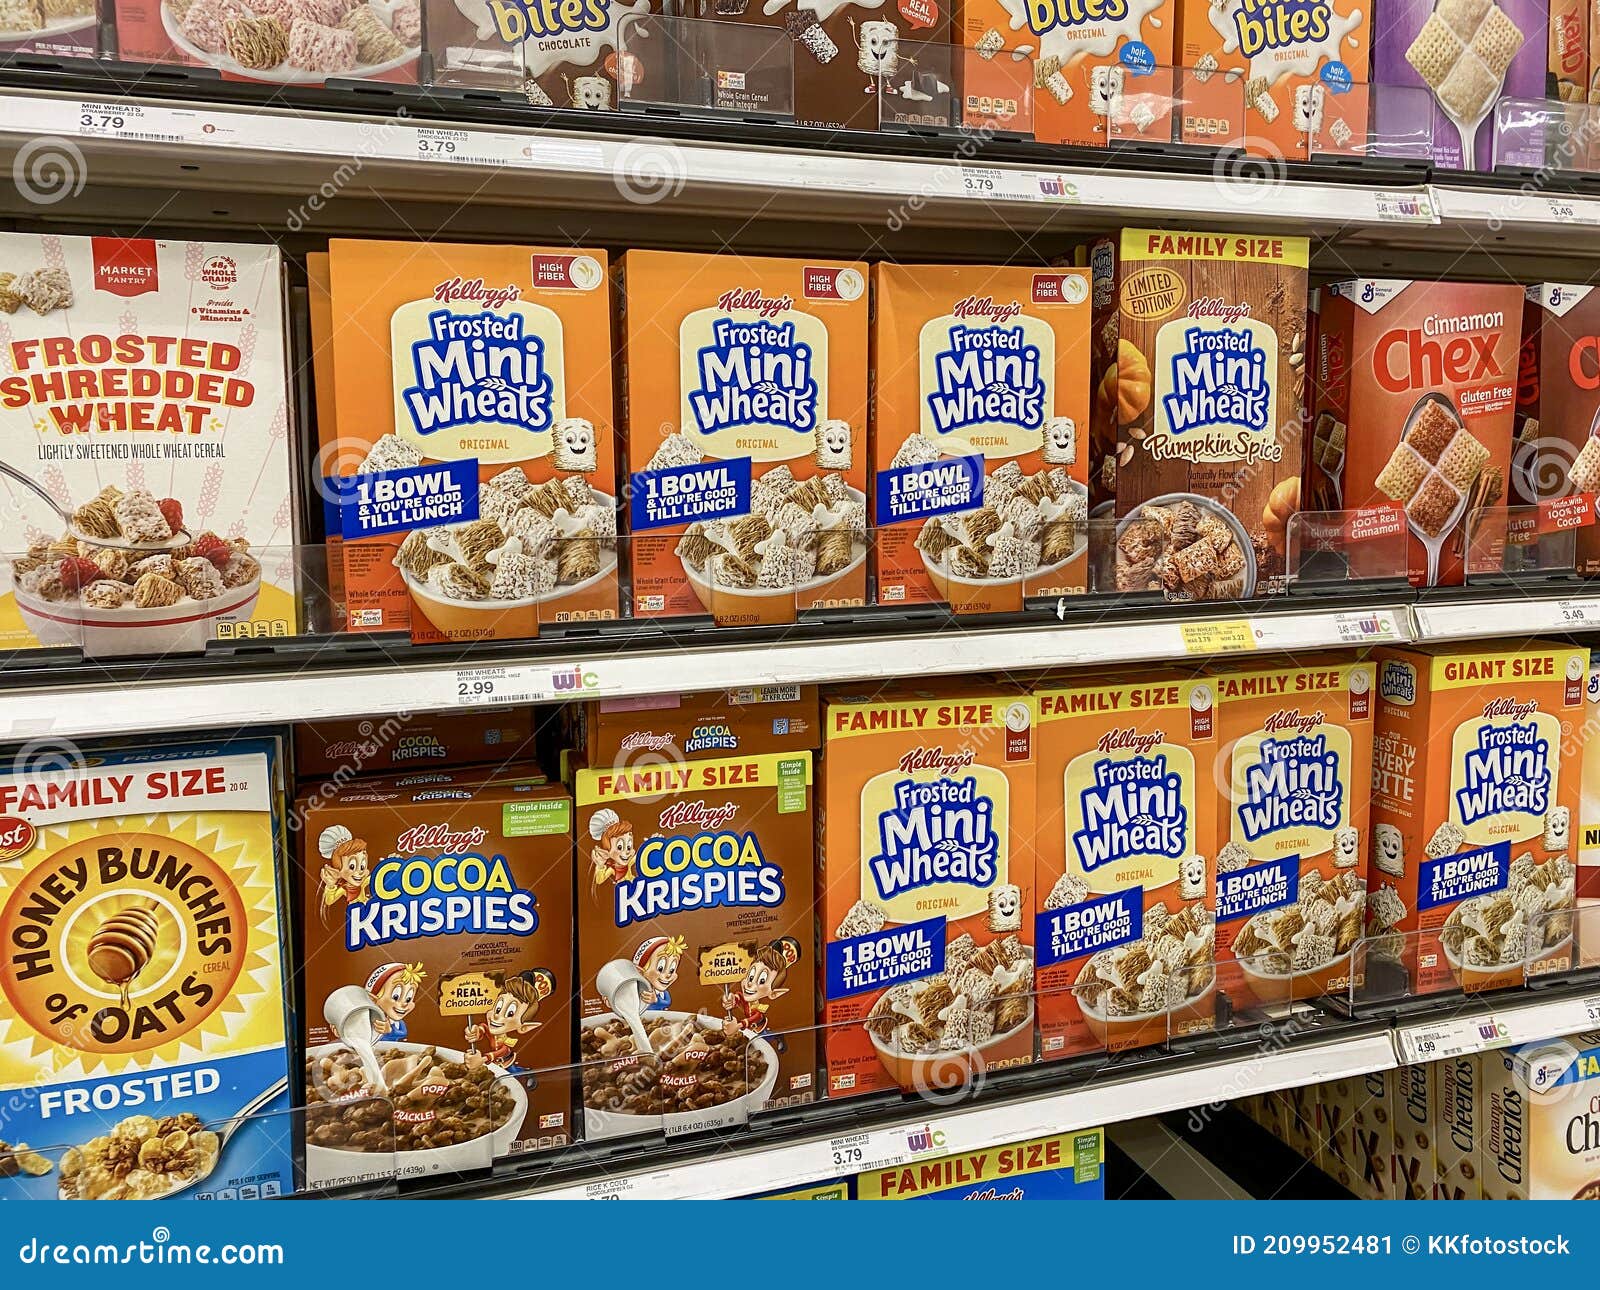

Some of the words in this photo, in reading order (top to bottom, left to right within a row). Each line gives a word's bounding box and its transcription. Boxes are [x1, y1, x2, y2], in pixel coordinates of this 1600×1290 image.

[901, 5, 936, 25] chocolate!
[909, 0, 930, 16] REAL
[489, 0, 610, 42] bites
[1237, 5, 1328, 53] bites
[1067, 28, 1106, 40] ORIGINAL
[1561, 8, 1584, 73] Chex
[538, 37, 591, 51] CHOCOLATE
[1130, 46, 1146, 57] half
[1274, 49, 1310, 62] ORIGINAL
[81, 108, 125, 116] STRAWBERRY
[103, 104, 141, 112] WHEATS
[80, 115, 124, 128] 3.79
[417, 128, 435, 137] MINI
[437, 130, 469, 138] WHEATS
[418, 140, 456, 153] 3.79
[964, 178, 994, 190] 3.79
[1040, 174, 1078, 196] wic
[1550, 206, 1574, 216] 3.49
[1148, 235, 1228, 256] FAMILY
[1234, 238, 1284, 258] SIZE
[100, 264, 153, 277] MARKET
[538, 271, 565, 281] FIBER
[539, 263, 563, 272] HIGH
[107, 276, 147, 285] PANTRY
[201, 275, 238, 283] GRAINS
[808, 283, 833, 292] FIBER
[809, 274, 831, 284] HIGH
[1127, 274, 1172, 298] LIMITED
[434, 277, 522, 309] Kellogg's
[199, 307, 241, 315] Vitamins
[1131, 294, 1176, 314] EDITION!
[1188, 297, 1250, 324] Kellogg's
[200, 314, 243, 322] Minerals
[1423, 311, 1504, 337] Cinnamon
[433, 315, 519, 341] Frosted
[11, 334, 242, 373] FROSTED
[1320, 333, 1328, 381] Cinnamon
[1372, 329, 1504, 393] Chex
[417, 339, 539, 390] Mini
[0, 368, 255, 409] SHREDDED
[1460, 390, 1490, 405] Gluten
[1493, 386, 1513, 399] Free
[408, 378, 548, 430] Wheats
[49, 402, 212, 436] WHEAT
[38, 444, 73, 460] LIGHTLY
[76, 444, 129, 459] SWEETENED
[131, 443, 161, 459] WHOLE
[163, 443, 193, 458] WHEAT
[194, 443, 226, 458] CEREAL
[459, 438, 510, 451] ORIGINAL
[1143, 435, 1233, 463] Pumpkin
[1232, 430, 1282, 466] Spice
[1188, 470, 1217, 481] Naturally
[1219, 469, 1246, 481] Flavored
[357, 482, 372, 505] 1
[375, 470, 461, 502] BOWL
[358, 503, 370, 516] &
[372, 496, 422, 514] YOU'RE
[425, 491, 462, 506] GOOD
[358, 511, 399, 529] TILL
[401, 501, 463, 524] LUNCH
[1352, 517, 1378, 528] 100%
[1380, 511, 1399, 524] Real
[1310, 526, 1340, 539] Gluten
[1351, 523, 1400, 540] Cinnamon
[557, 612, 570, 621] 210
[1359, 612, 1391, 633] wic
[1562, 609, 1585, 620] 3.49
[219, 624, 232, 634] 210
[552, 665, 599, 690] wic
[1445, 661, 1506, 681] GIANT
[1512, 657, 1554, 677] SIZE
[458, 681, 494, 695] 2.99
[1385, 672, 1412, 687] Mini
[760, 686, 780, 695] LEARN
[782, 686, 797, 694] MORE
[1382, 685, 1413, 700] Wheats
[1041, 691, 1123, 715] FAMILY
[1130, 686, 1180, 708] SIZE
[836, 706, 929, 731] FAMILY
[937, 705, 993, 726] SIZE
[692, 725, 731, 739] COCOA
[621, 732, 674, 750] Kellogg's
[685, 736, 737, 752] KRISPIES
[1009, 745, 1028, 753] FIBER
[1010, 738, 1027, 746] HIGH
[1099, 729, 1164, 754] Kellogg's
[122, 749, 219, 762] FROSTED
[1402, 744, 1416, 759] IN
[780, 761, 802, 769] Simple
[782, 768, 801, 776] Inside
[1373, 751, 1415, 776] EVERY
[597, 773, 693, 796] FAMILY
[702, 763, 759, 786] SIZE
[1097, 760, 1163, 787] Frosted
[0, 775, 134, 815] FAMILY
[146, 767, 226, 800] SIZE
[229, 784, 239, 793] 20
[240, 782, 248, 791] OZ
[1372, 770, 1414, 801] BITE
[509, 802, 539, 812] Simple
[540, 801, 563, 810] Inside
[1083, 778, 1178, 832] Mini
[397, 823, 486, 854] Kellogg's
[1077, 812, 1184, 868] Wheats
[374, 856, 513, 900] COCOA
[915, 898, 960, 911] ORIGINAL
[12, 857, 88, 982] HONEY
[97, 847, 232, 957] BUNCHES
[349, 892, 535, 947] KRISPIES
[461, 948, 490, 958] SWEETENED
[503, 946, 522, 955] CEREAL
[203, 959, 231, 974] CEREAL
[456, 987, 484, 998] REAL
[45, 992, 88, 1026] of
[90, 974, 214, 1044] OATS
[445, 997, 493, 1008] Chocolate
[1478, 1017, 1509, 1040] wic
[1418, 1040, 1436, 1053] 4.99
[612, 1055, 639, 1071] SNAP!
[40, 1068, 221, 1119] FROSTED
[422, 1085, 447, 1095] POP!
[394, 1110, 436, 1122] CRACKLE!
[1488, 1091, 1501, 1154] Cinnamon
[831, 1138, 844, 1146] MINI
[845, 1134, 869, 1143] WHEATS
[907, 1124, 946, 1152] wic
[1498, 1086, 1522, 1185] Cheerios
[832, 1148, 863, 1165] 3.79
[403, 1165, 426, 1175] (439g)
[881, 1154, 988, 1198] FAMILY
[998, 1140, 1061, 1175] SIZE
